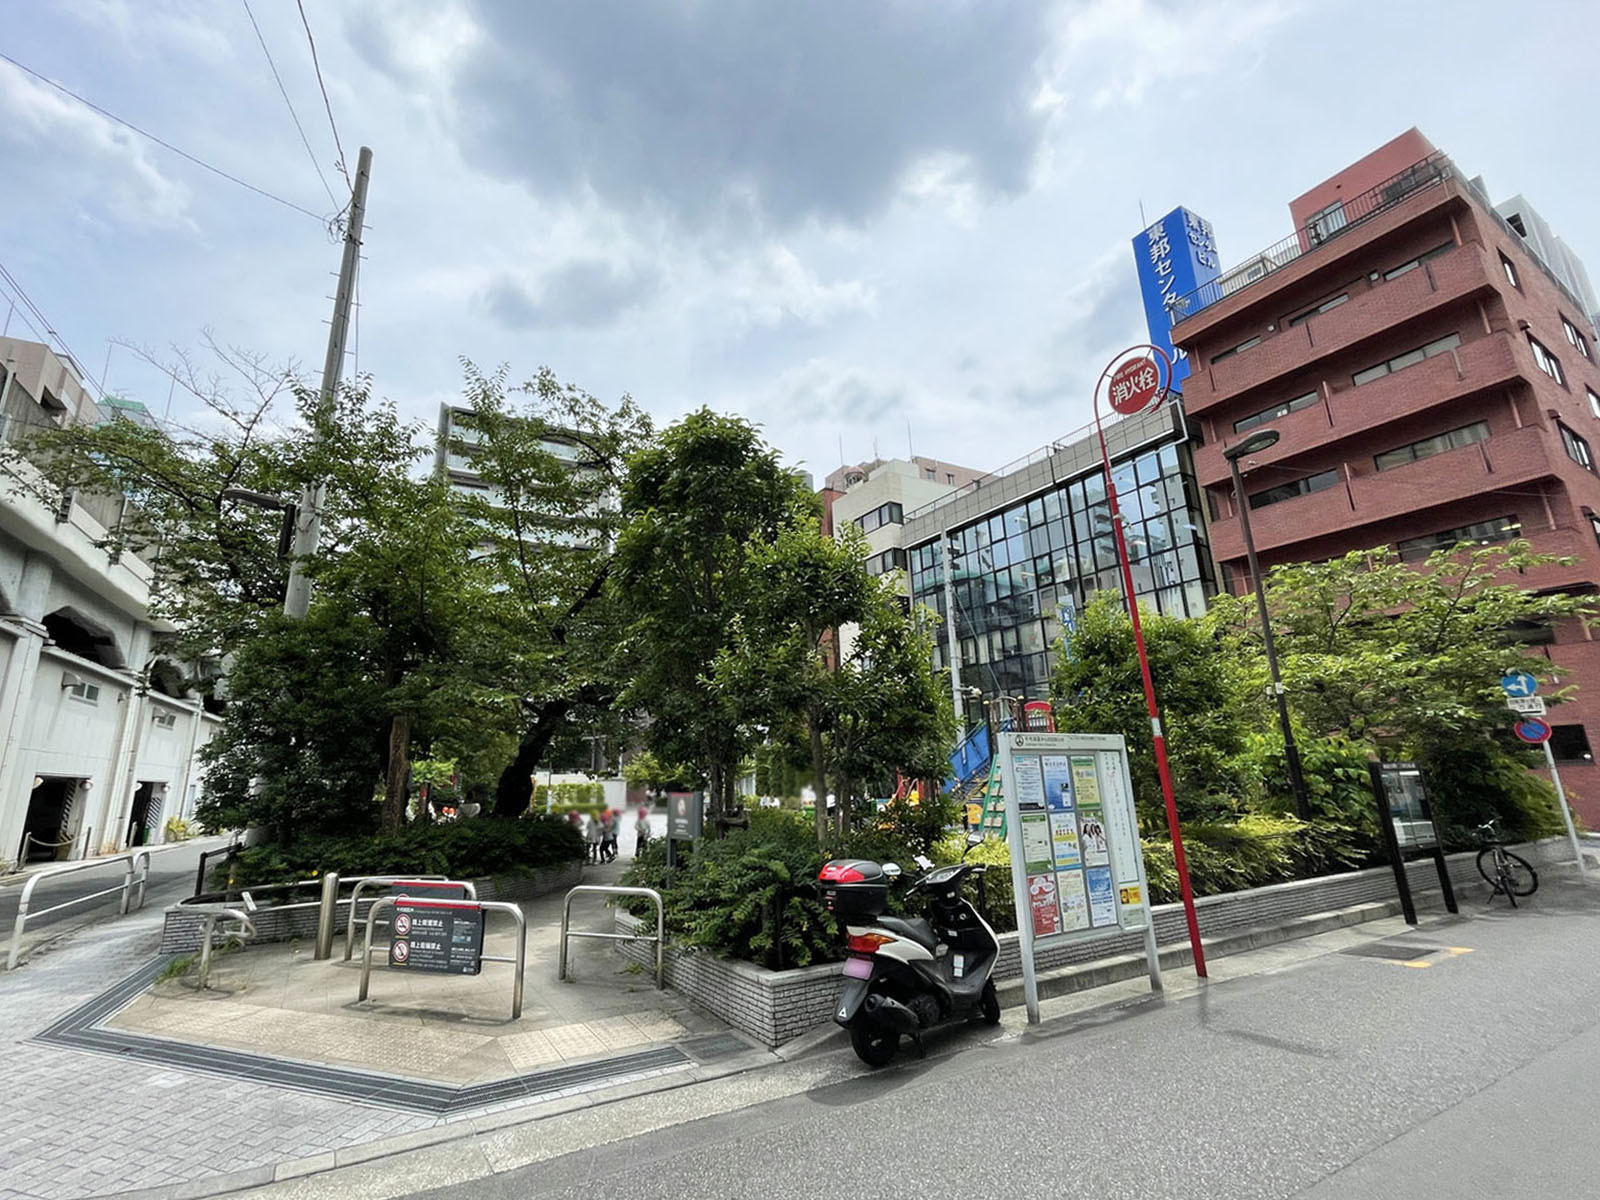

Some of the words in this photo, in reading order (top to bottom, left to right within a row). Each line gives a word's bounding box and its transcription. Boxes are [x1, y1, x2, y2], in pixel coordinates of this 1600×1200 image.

[1196, 250, 1216, 269] ビル
[1112, 366, 1156, 407] 消火栓
